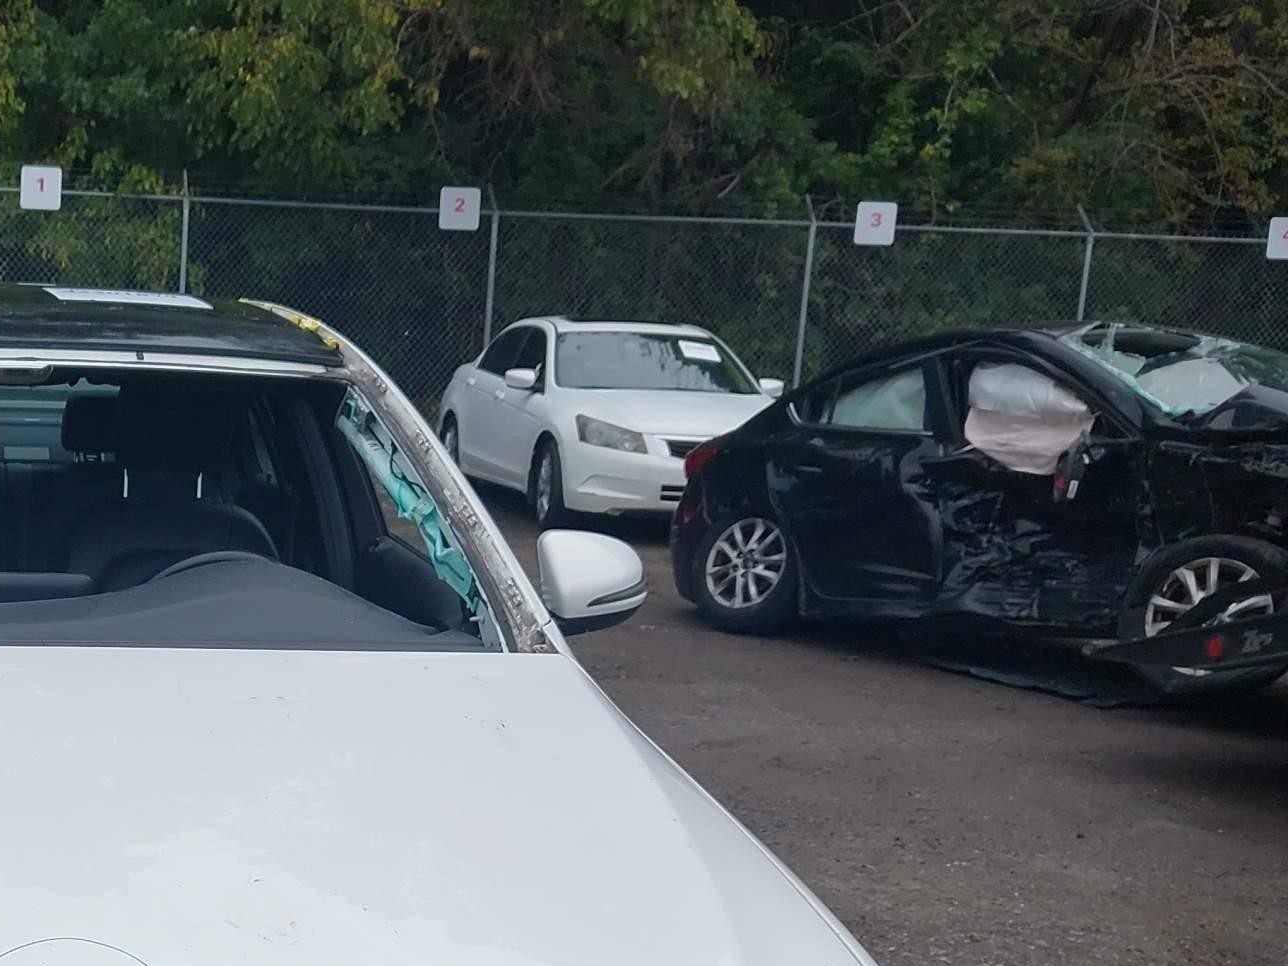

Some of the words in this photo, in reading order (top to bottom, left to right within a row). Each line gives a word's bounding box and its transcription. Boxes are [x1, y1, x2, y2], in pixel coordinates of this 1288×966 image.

[36, 177, 45, 193] 1
[455, 198, 465, 213] 2
[871, 212, 882, 227] 3
